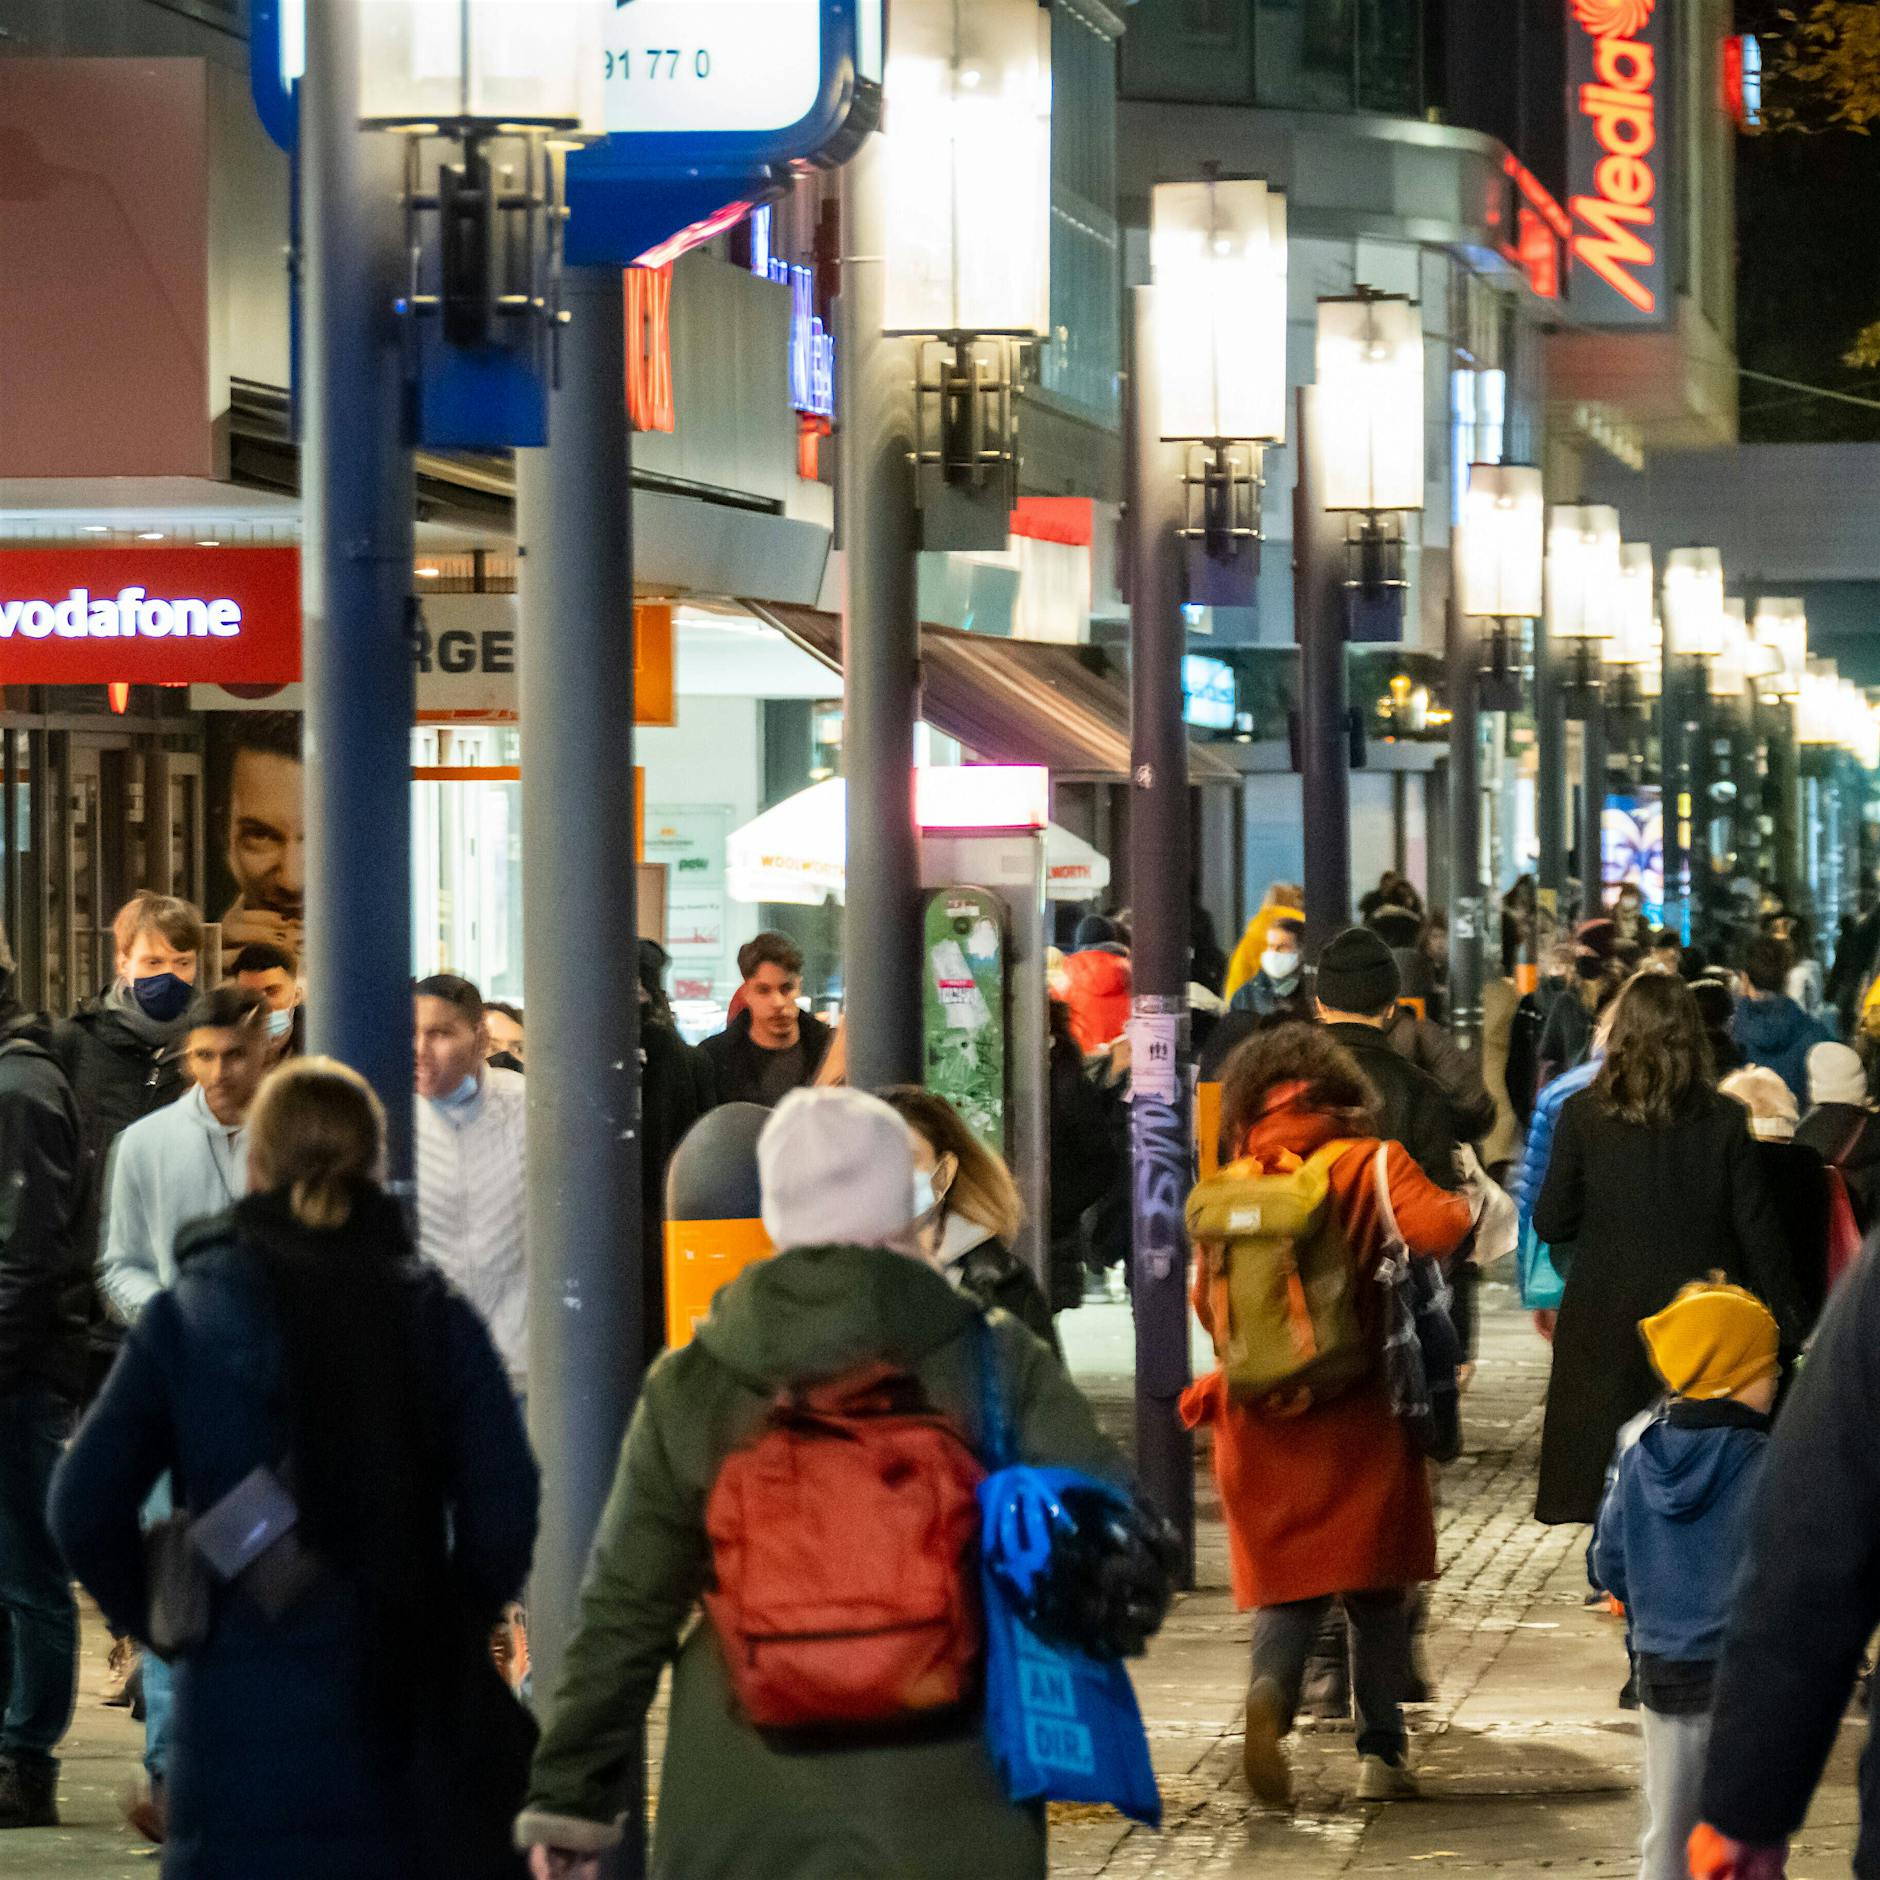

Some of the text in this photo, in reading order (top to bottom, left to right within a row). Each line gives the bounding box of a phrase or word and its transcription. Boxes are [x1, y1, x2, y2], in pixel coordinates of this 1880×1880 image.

[646, 49, 681, 79] 77
[695, 49, 710, 79] 0
[0, 585, 242, 639] vodafone
